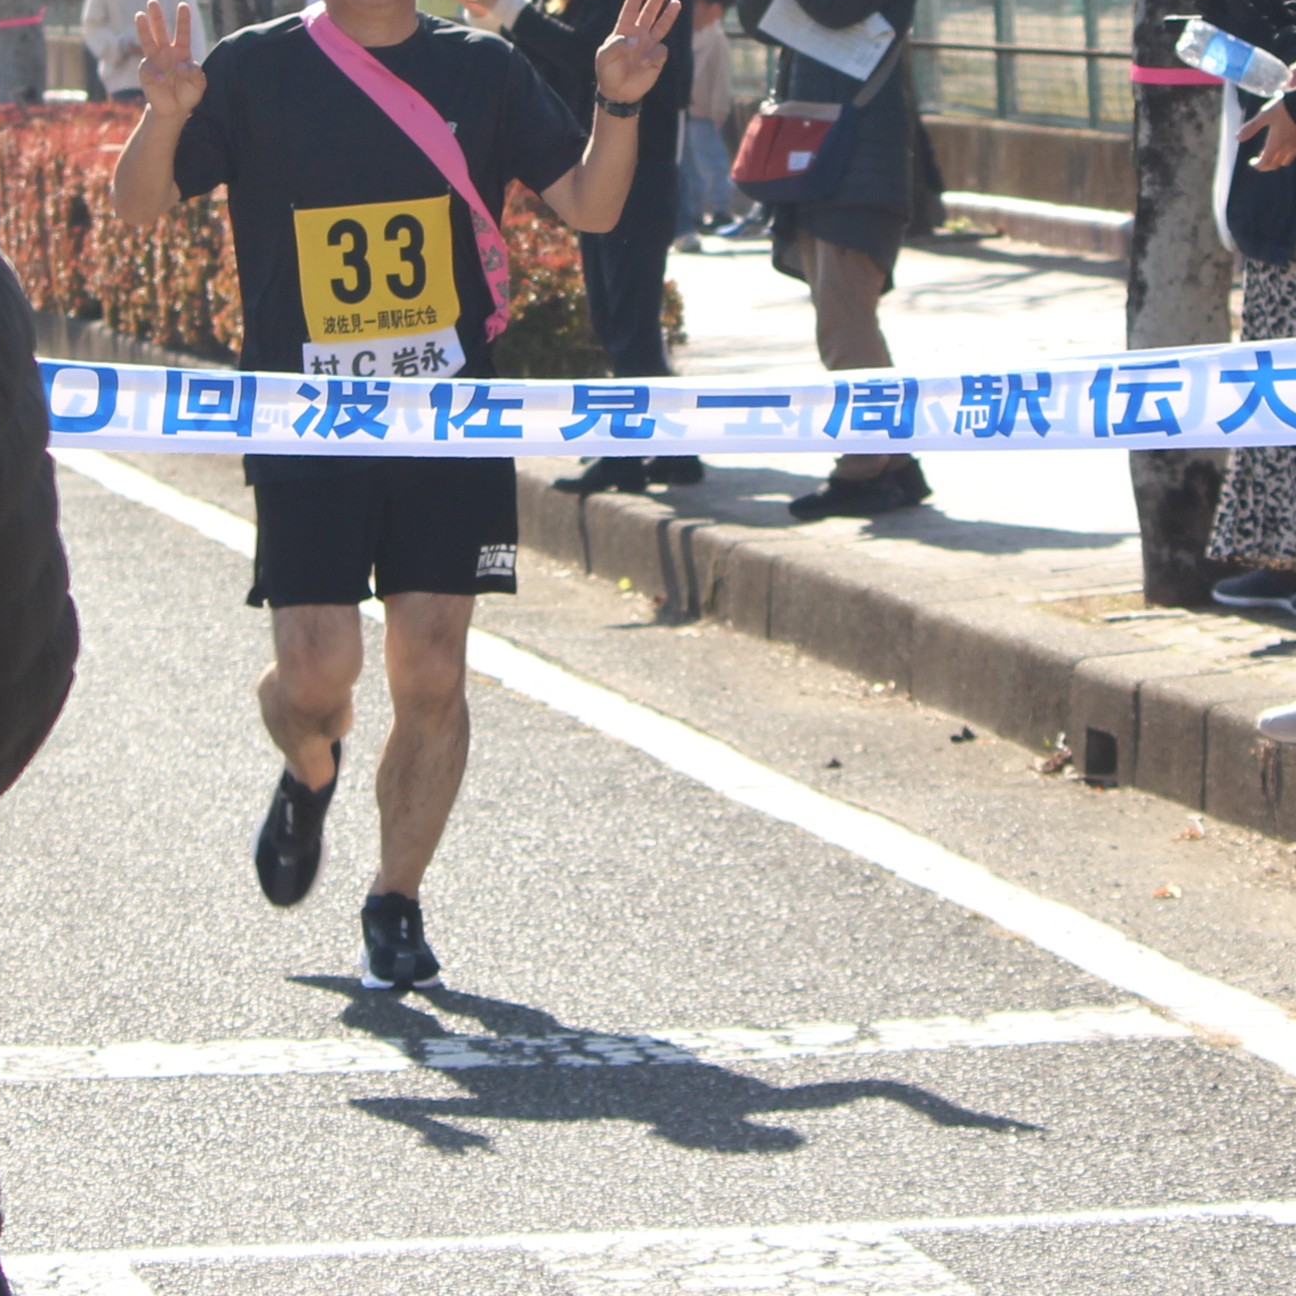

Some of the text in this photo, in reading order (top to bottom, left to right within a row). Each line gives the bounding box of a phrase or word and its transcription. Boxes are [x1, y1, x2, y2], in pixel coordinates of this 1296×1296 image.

[327, 213, 427, 305] 33
[323, 304, 438, 336] 波佐見一周駅伝大会
[351, 350, 377, 377] C
[391, 341, 450, 377] 岩永
